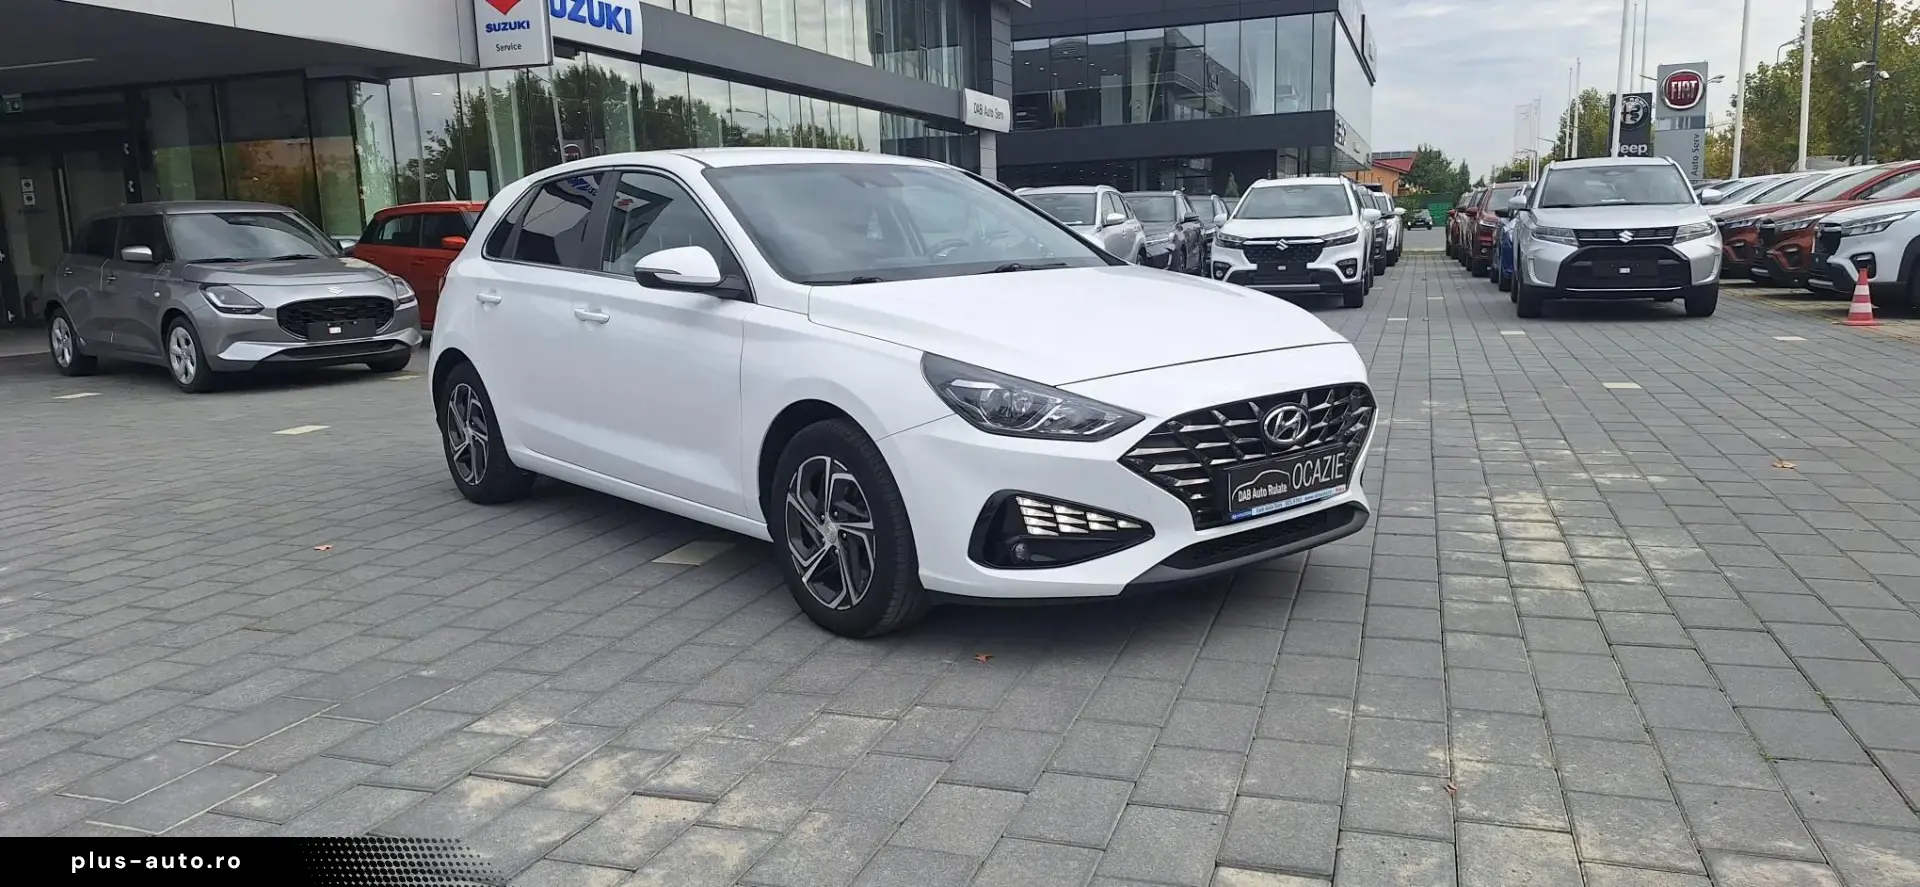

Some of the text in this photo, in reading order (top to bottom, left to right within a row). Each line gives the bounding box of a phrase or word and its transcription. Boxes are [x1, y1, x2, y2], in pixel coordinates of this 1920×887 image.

[485, 20, 531, 33] SUZUKI
[550, 0, 632, 35] UZUKI
[495, 42, 522, 52] Service
[1670, 80, 1698, 100] FIAT
[1619, 143, 1648, 156] eep
[1691, 133, 1700, 153] Serv
[1691, 155, 1700, 177] Auto
[1292, 452, 1345, 490] OCAZIE
[1237, 489, 1252, 503] DAB
[1252, 486, 1267, 500] Auto
